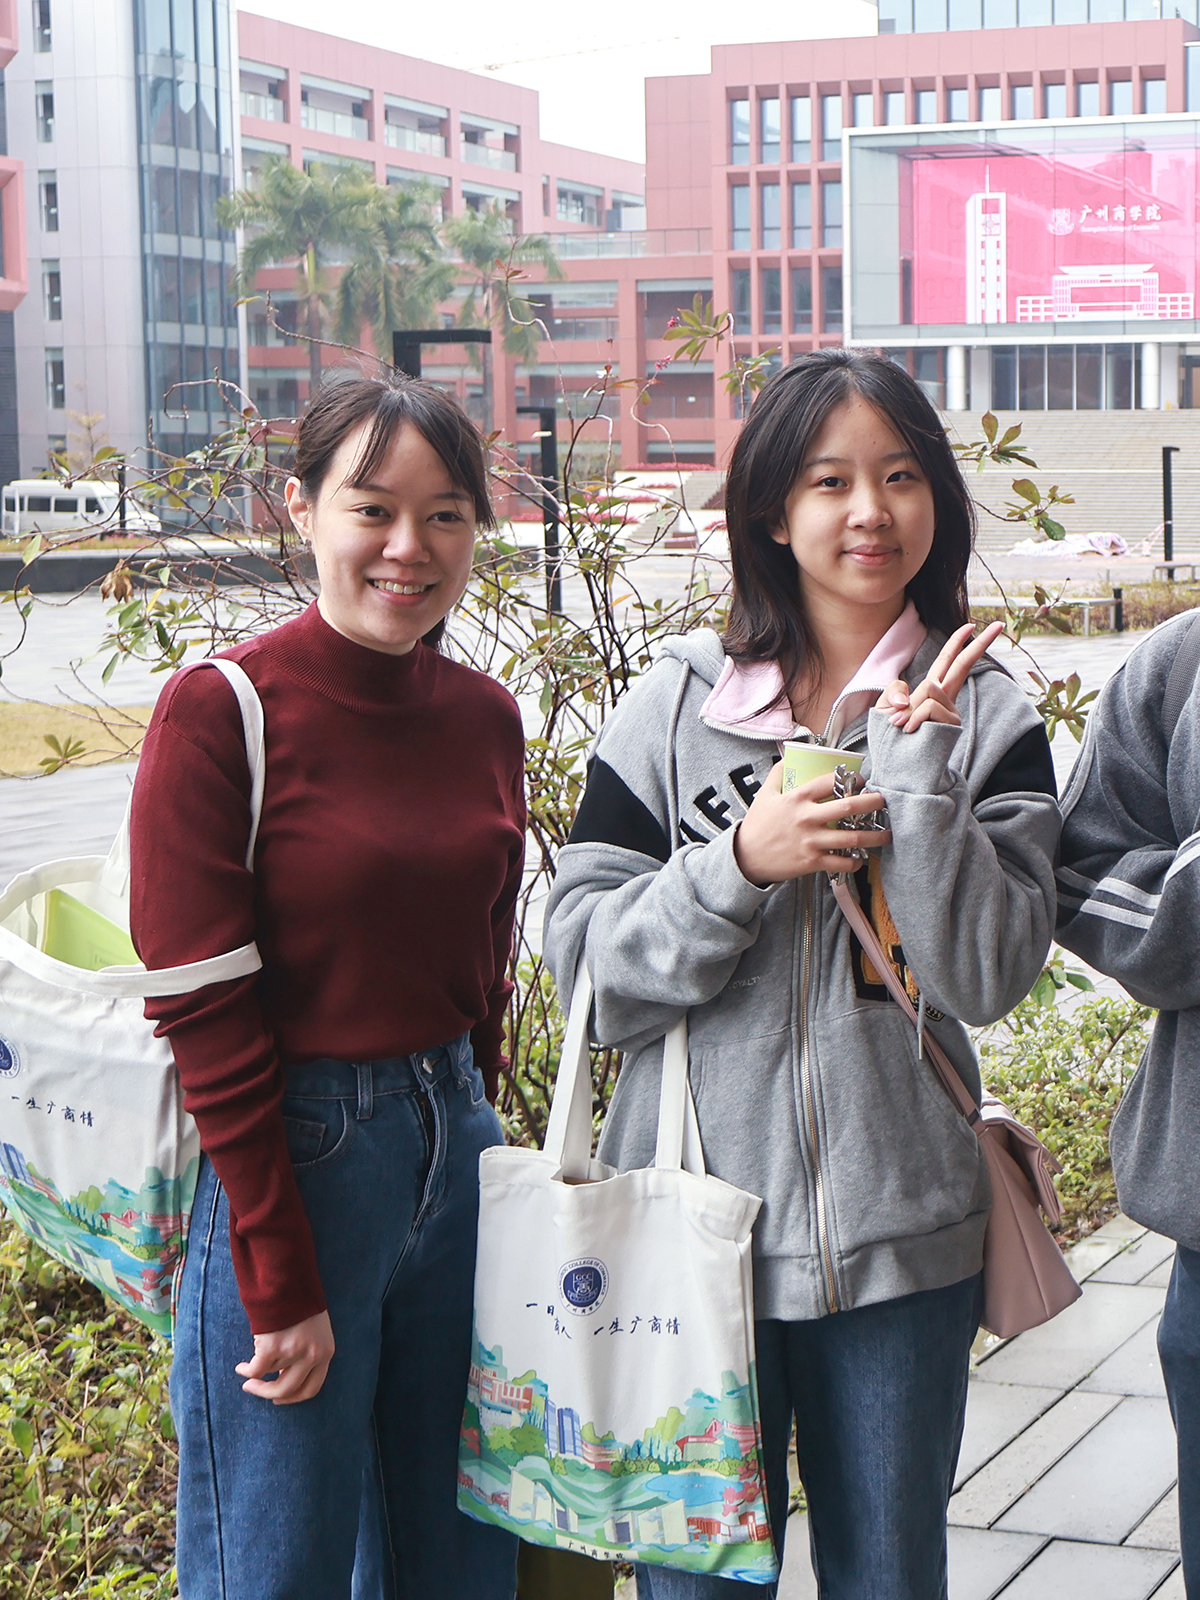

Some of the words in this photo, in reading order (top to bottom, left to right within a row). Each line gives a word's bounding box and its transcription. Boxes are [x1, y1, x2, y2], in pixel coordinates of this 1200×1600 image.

[1079, 204, 1161, 224] 广州商学院
[728, 975, 763, 989] OYALTY
[11, 1095, 94, 1128] 一生广商情
[593, 1315, 681, 1336] 一生广商情
